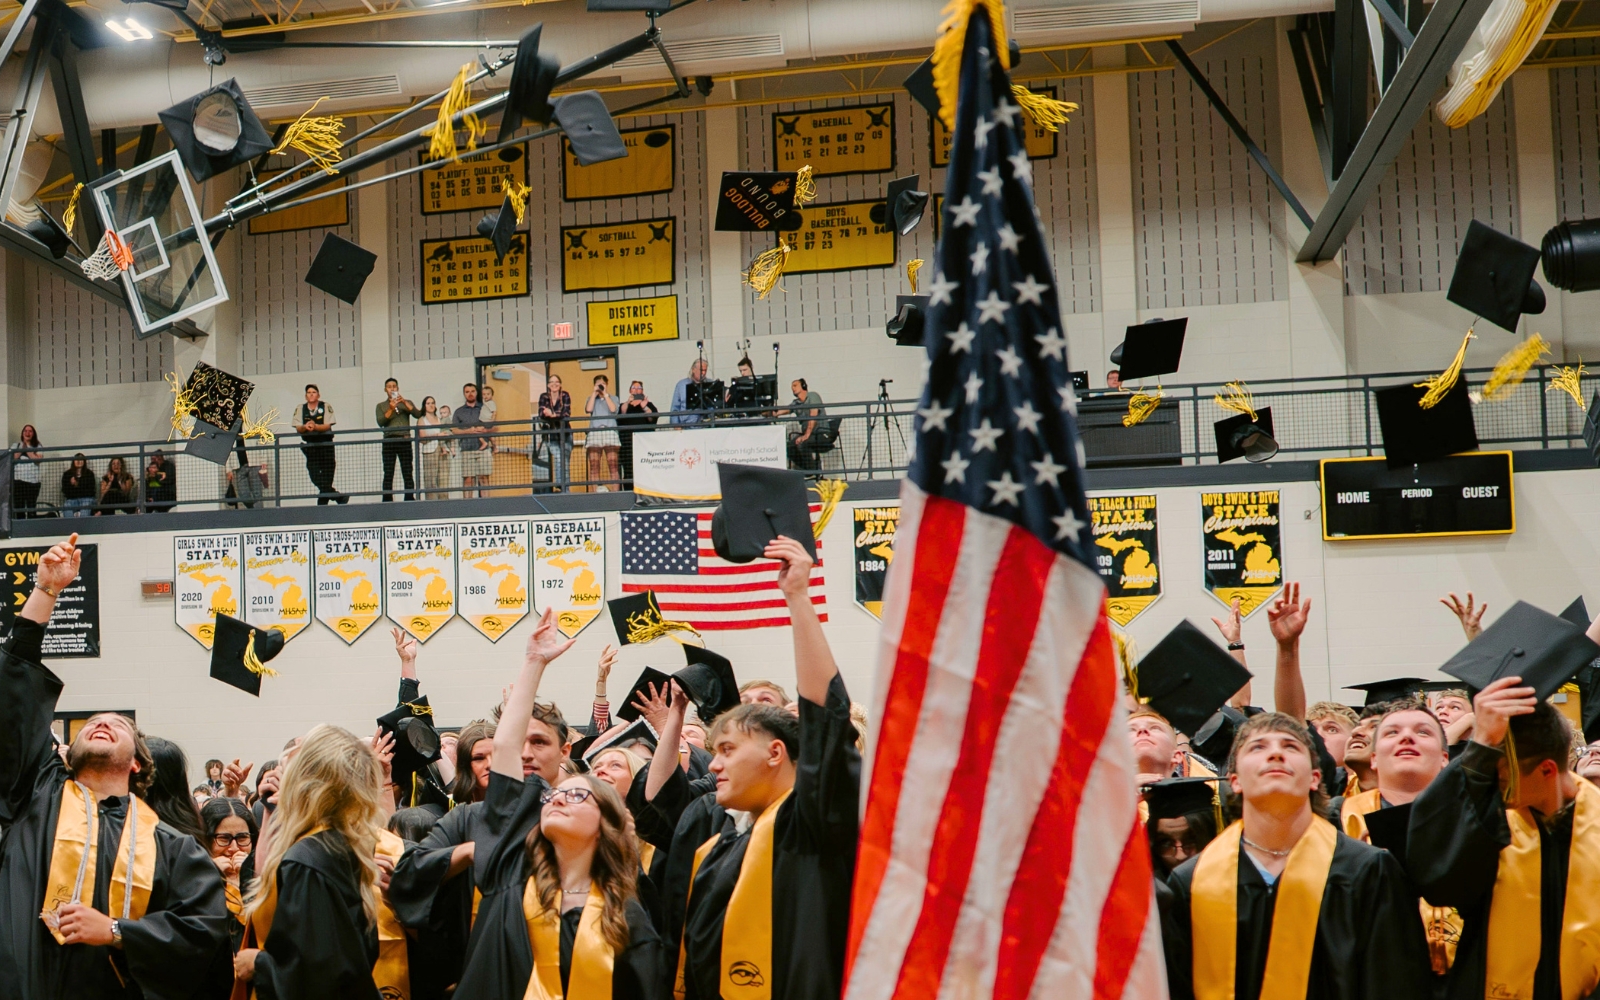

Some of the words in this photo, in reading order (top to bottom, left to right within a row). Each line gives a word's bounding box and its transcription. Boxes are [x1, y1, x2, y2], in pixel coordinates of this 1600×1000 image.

[813, 117, 852, 128] BASEBALL
[785, 139, 793, 147] 71
[802, 137, 812, 146] 72
[837, 147, 848, 155] 22
[438, 169, 469, 179] PLAYOFF
[474, 165, 510, 175] QUALIFIER
[740, 178, 786, 219] BOUND
[725, 187, 770, 229] BULLDOG
[826, 208, 846, 217] BOYS
[811, 216, 861, 228] BASKETBALL
[599, 231, 636, 242] SOFTBALL
[822, 231, 832, 239] 75
[822, 241, 832, 249] 23
[609, 305, 655, 319] DISTRICT
[557, 325, 571, 337] EXIT
[613, 323, 653, 337] CHAMPS
[710, 448, 738, 456] Hamilton
[1402, 488, 1432, 498] PERIOD
[1463, 486, 1499, 498] GUEST
[1100, 497, 1125, 510] TRACK
[1127, 497, 1132, 508] &
[1135, 496, 1156, 509] FIELD
[1202, 492, 1223, 506] BOYS
[1226, 491, 1248, 505] SWIM
[1251, 492, 1256, 503] &
[1259, 491, 1279, 504] DIVE
[1337, 492, 1369, 504] HOME
[855, 508, 874, 521] BOYS
[1092, 510, 1145, 523] STATE
[1214, 505, 1268, 518] STATE
[536, 522, 600, 534] BASEBALL
[1092, 520, 1154, 535] hampions
[1204, 515, 1278, 533] Champions
[315, 532, 331, 542] GIRLS
[333, 529, 379, 541] CROSS-COUNTRY
[387, 529, 403, 539] GIRLS
[405, 527, 452, 538] CROSS-COUNTRY
[461, 524, 525, 536] BASEBALL
[178, 539, 195, 549] GIRLS
[198, 539, 214, 548] SWIM
[217, 539, 220, 547] &
[223, 537, 237, 547] DIVE
[247, 535, 262, 545] BOYS
[265, 534, 283, 544] SWIM
[285, 534, 289, 542] &
[292, 533, 307, 542] DIVE
[398, 539, 442, 550] STATE
[470, 537, 516, 548] STATE
[546, 535, 592, 545] STATE
[256, 545, 298, 556] STATE
[326, 542, 369, 553] STATE
[5, 552, 39, 566] GYM
[187, 550, 229, 560] STATE
[1208, 550, 1233, 561] 2011
[860, 560, 885, 571] 1984
[319, 582, 340, 590] 2010
[391, 581, 412, 589] 2009
[541, 580, 563, 588] 1972
[464, 586, 486, 594] 1986
[182, 592, 202, 601] 2020
[252, 596, 273, 605] 2010
